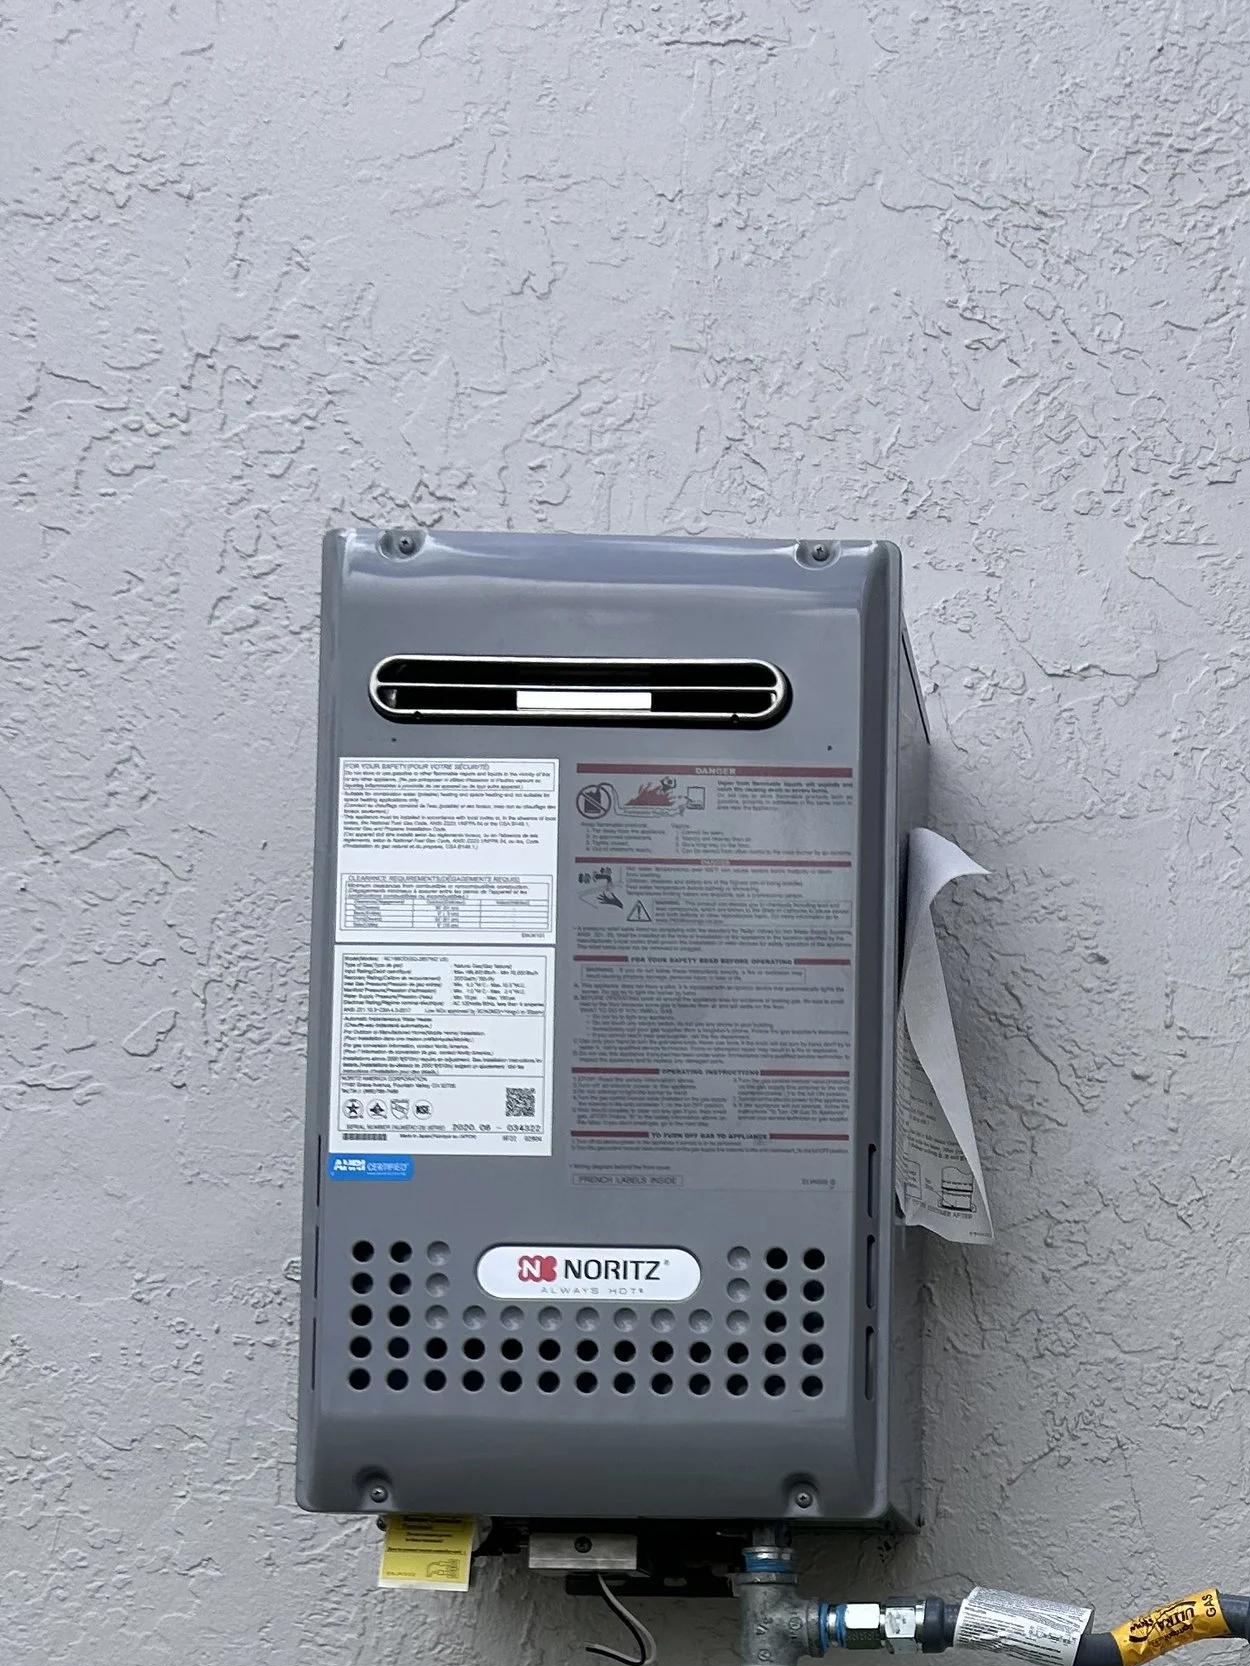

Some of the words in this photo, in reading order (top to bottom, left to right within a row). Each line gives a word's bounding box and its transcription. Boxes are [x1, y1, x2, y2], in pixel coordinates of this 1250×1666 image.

[695, 767, 736, 775] DANGER
[367, 1162, 407, 1172] CERTIFIED
[579, 1176, 612, 1184] FRENCH
[616, 1176, 647, 1184] LABELS
[650, 1176, 676, 1184] INSIDE
[564, 1259, 661, 1280] NORITZ
[540, 1286, 600, 1295] ALWAYS
[1202, 1594, 1217, 1617] GAS
[1156, 1607, 1195, 1631] ULTRA
